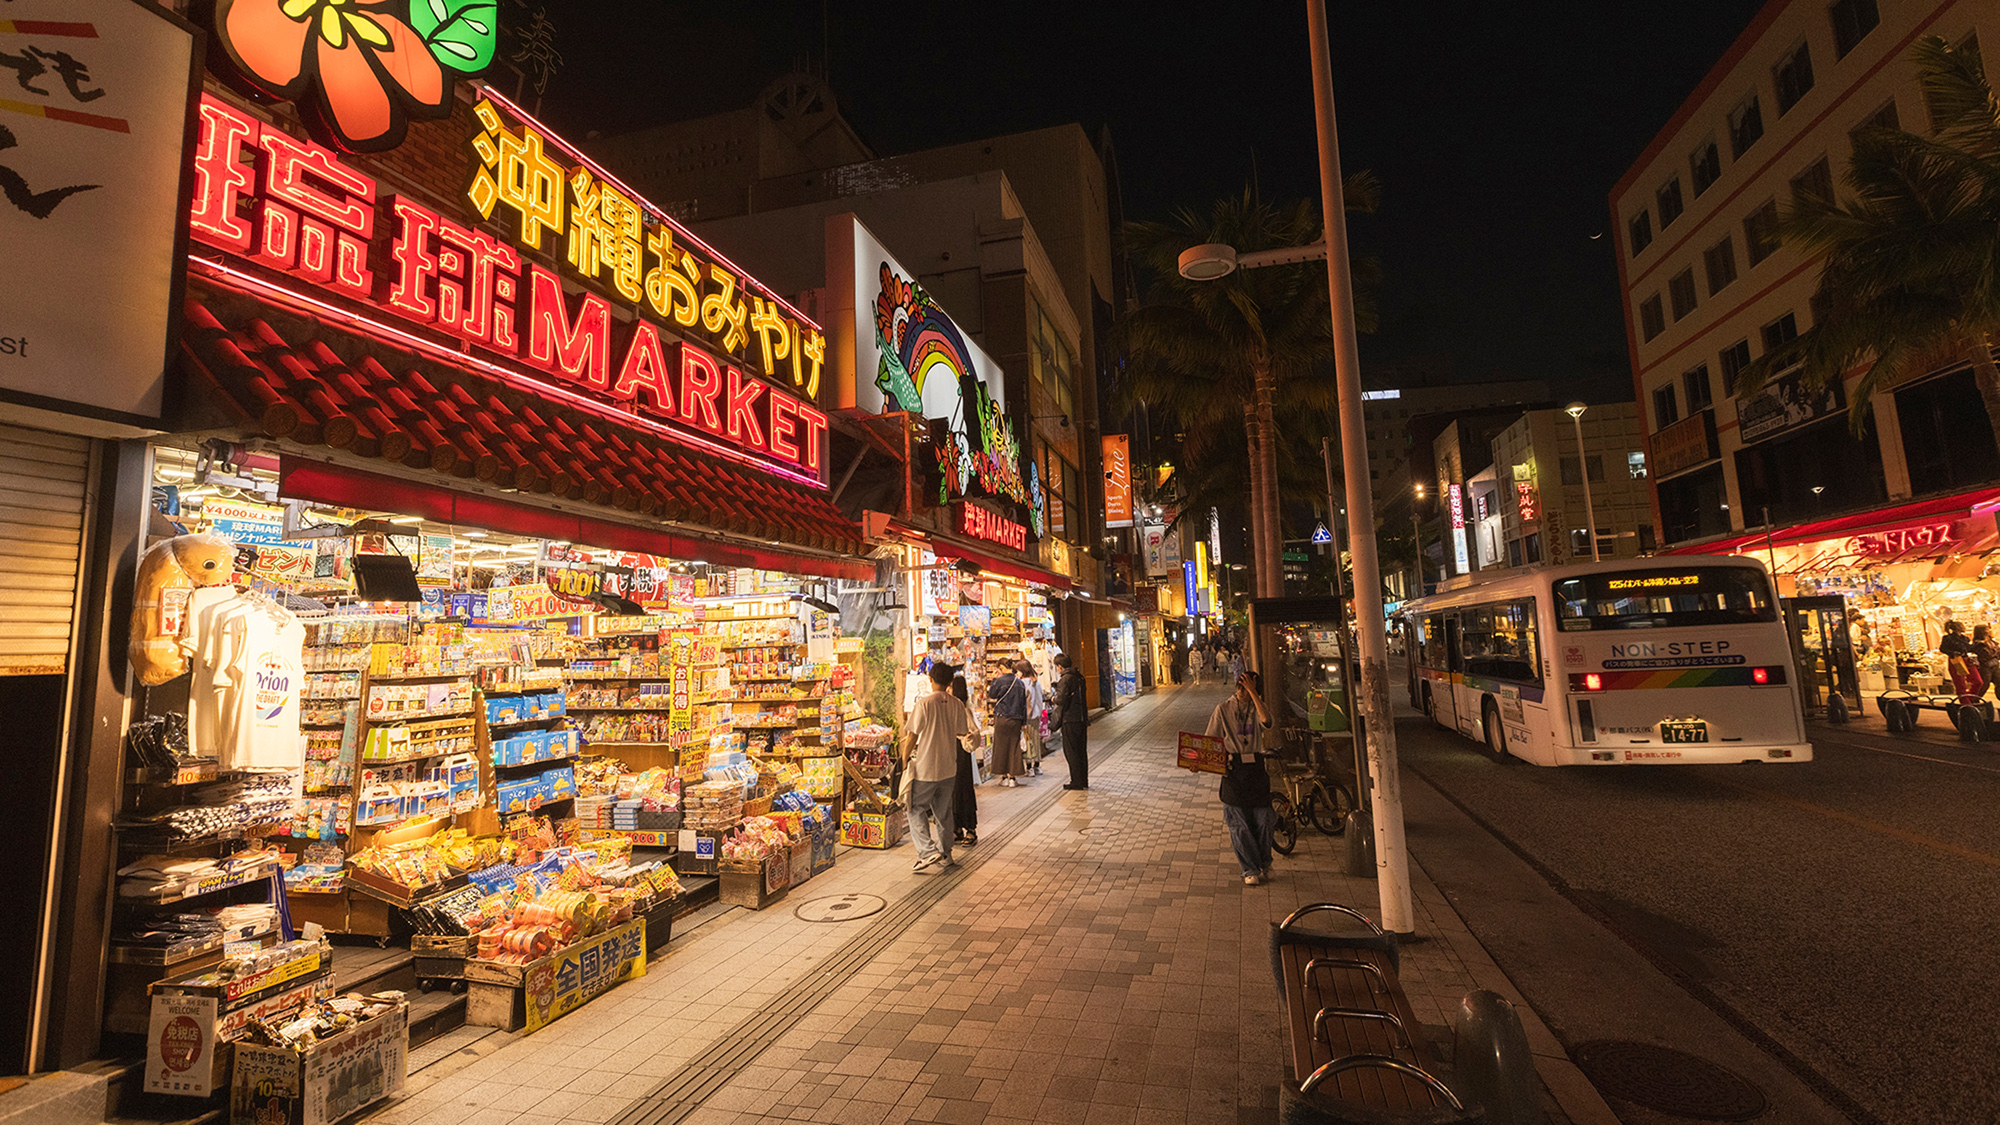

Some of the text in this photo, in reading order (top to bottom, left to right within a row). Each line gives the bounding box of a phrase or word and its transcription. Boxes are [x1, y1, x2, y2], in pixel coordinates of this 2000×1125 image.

[466, 97, 826, 401] 沖縄おみやげ
[963, 501, 1027, 552] 琉球MARKET
[990, 608, 1015, 618] SPAM
[1611, 640, 1730, 657] NON-STEP
[1671, 729, 1706, 742] 14-77
[1200, 751, 1225, 763] ¥950
[554, 925, 643, 998] 全国発送
[168, 1006, 201, 1015] WELCOME
[166, 1026, 199, 1041] 免税店
